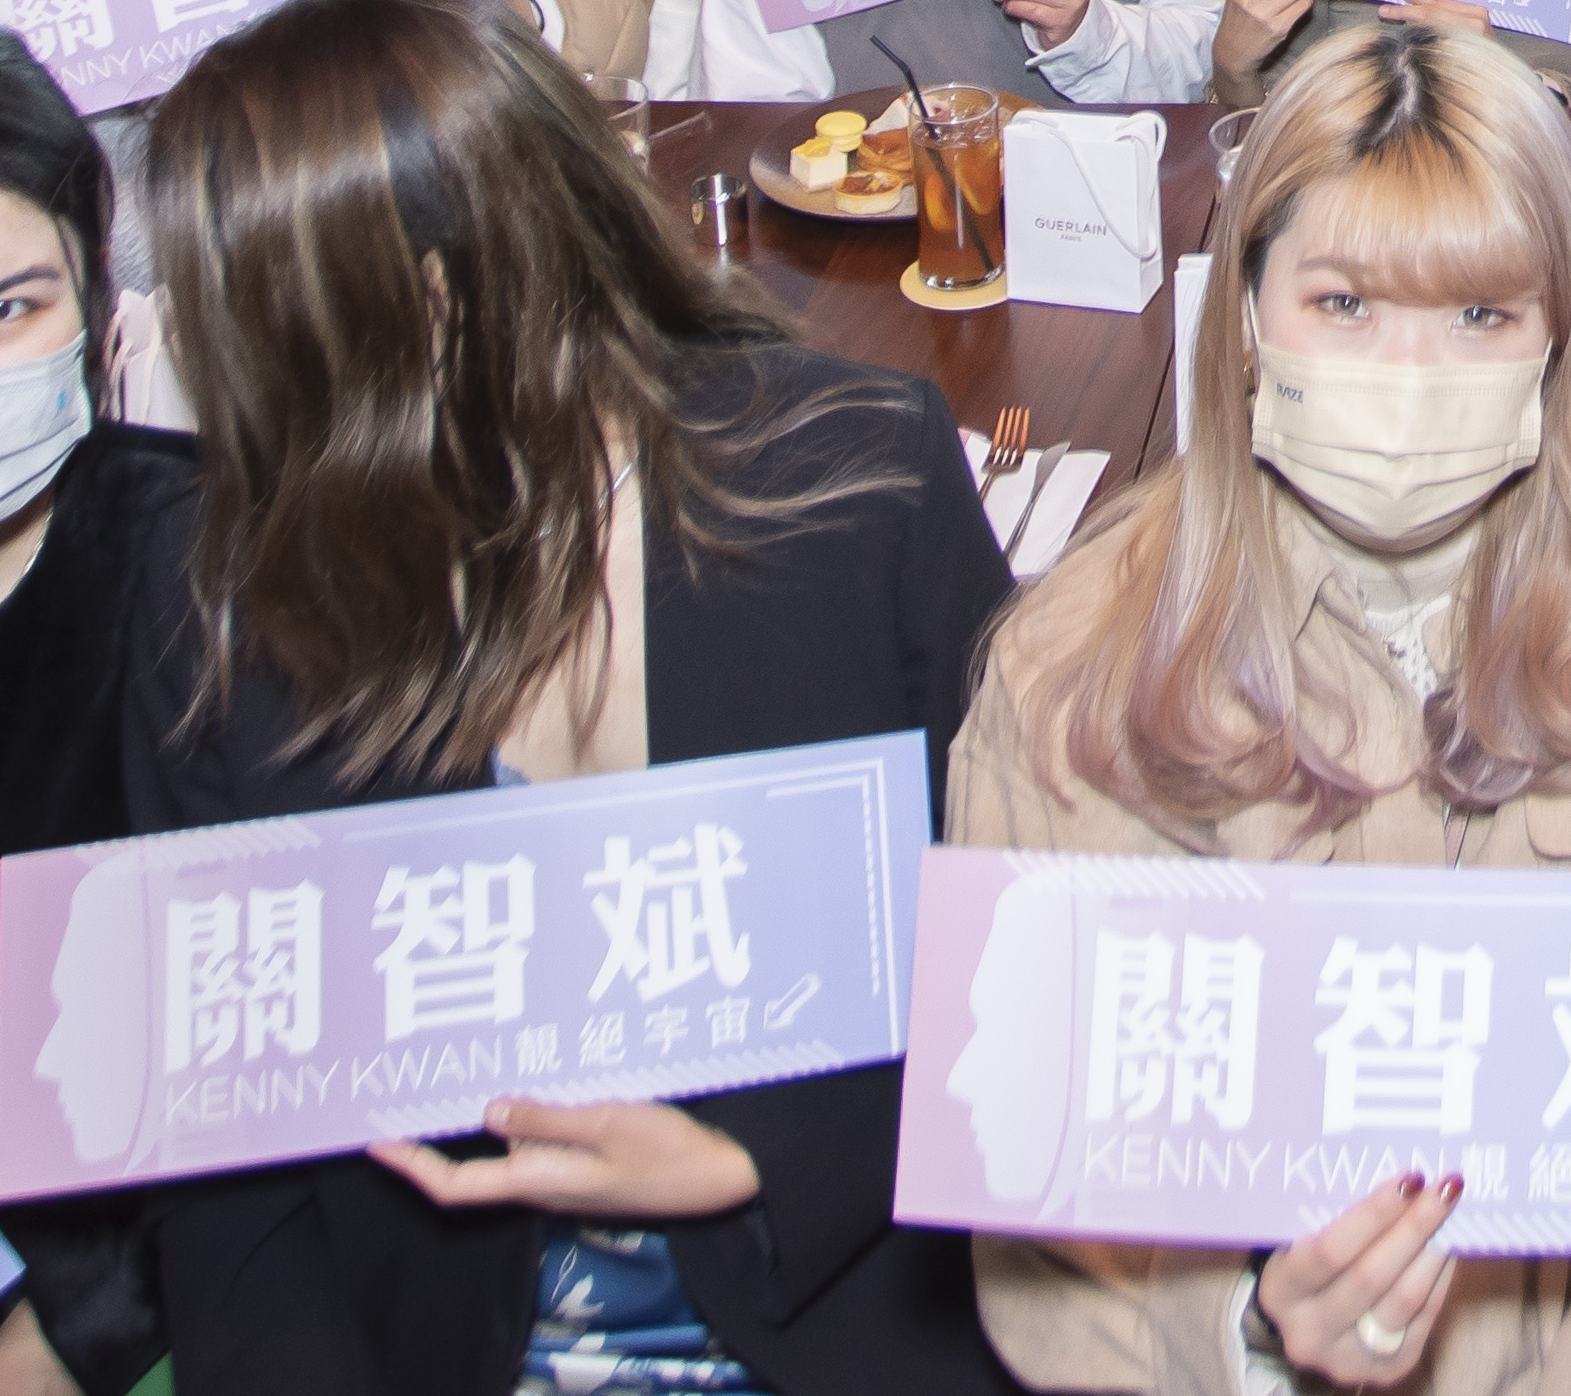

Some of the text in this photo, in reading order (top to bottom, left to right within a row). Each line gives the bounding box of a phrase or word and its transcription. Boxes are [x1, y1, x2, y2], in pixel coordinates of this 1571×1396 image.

[49, 46, 135, 88] NNY
[1034, 217, 1108, 237] GUERLAIN
[162, 822, 752, 1072] 關智斌
[164, 1060, 343, 1128] KENNY
[349, 1038, 506, 1102] KWAN
[1083, 1133, 1272, 1193] KENNY
